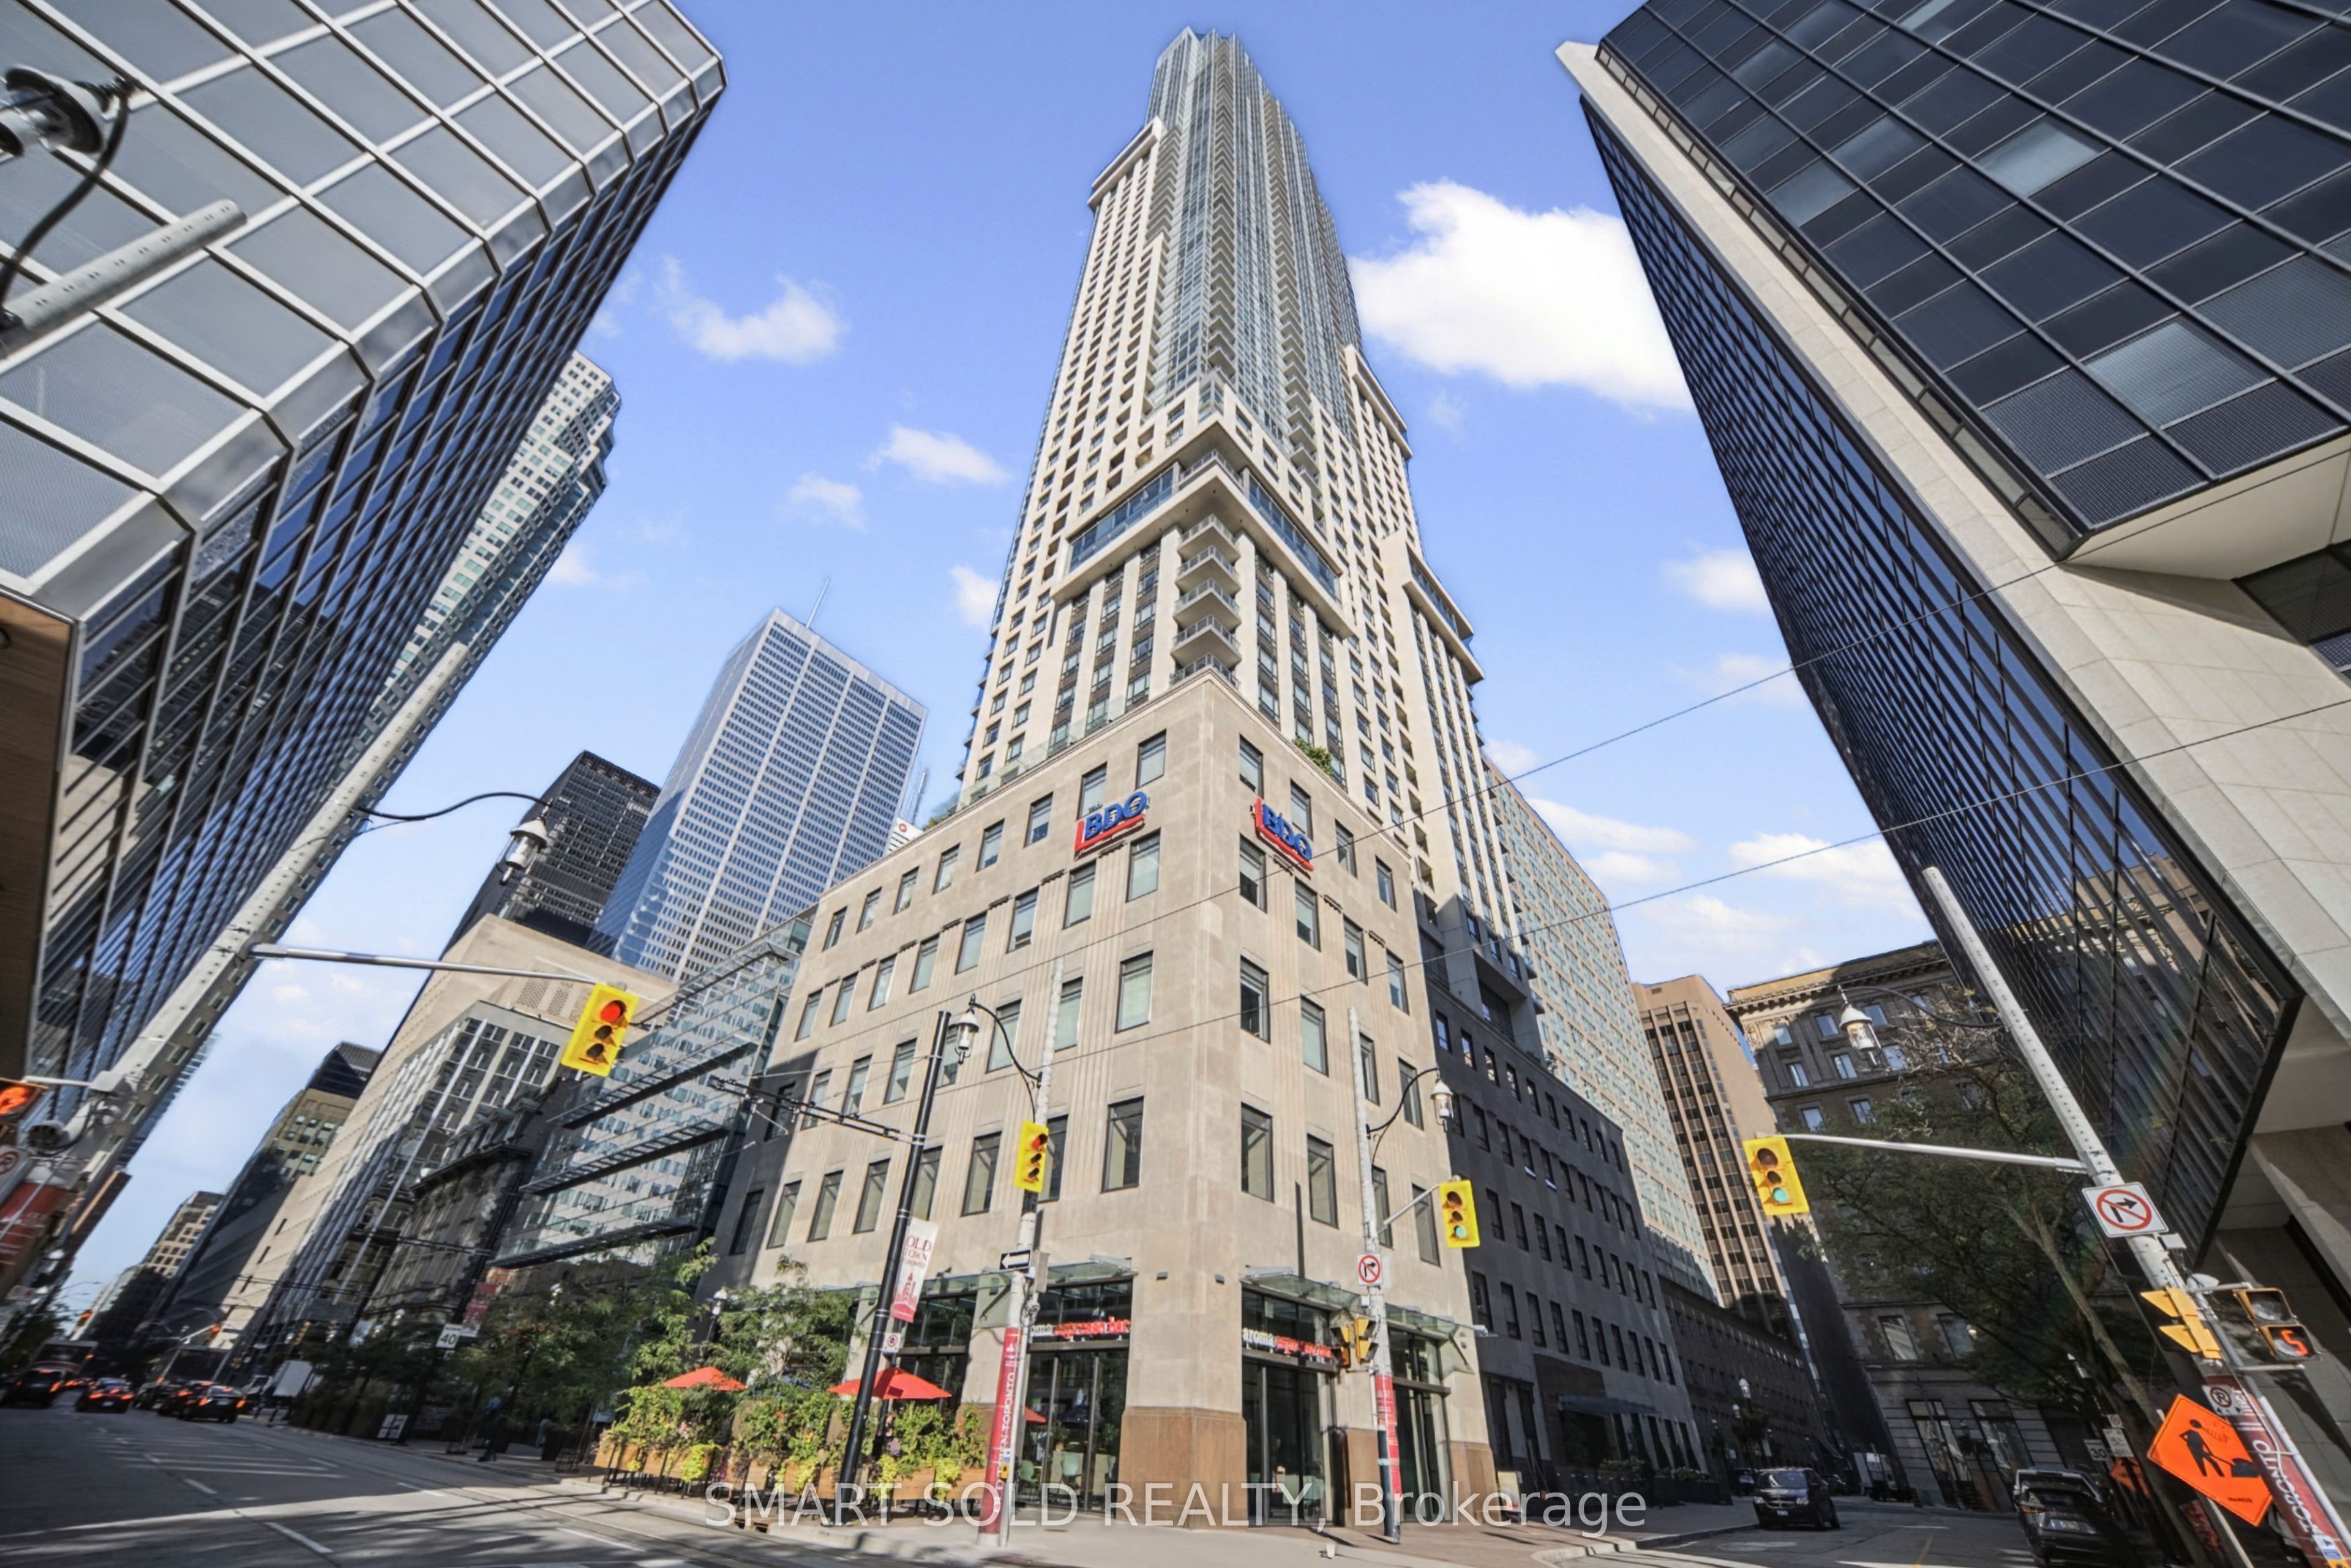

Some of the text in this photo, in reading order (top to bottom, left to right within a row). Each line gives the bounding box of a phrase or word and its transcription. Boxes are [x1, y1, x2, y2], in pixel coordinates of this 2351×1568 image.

[1083, 790, 1148, 841] BDO
[1261, 803, 1313, 861] BDO
[906, 1235, 932, 1251] OLD
[440, 1334, 457, 1345] 40
[1242, 1327, 1274, 1347] aroma
[1002, 1373, 1014, 1431] TORONTO
[2090, 1448, 2107, 1458] 30
